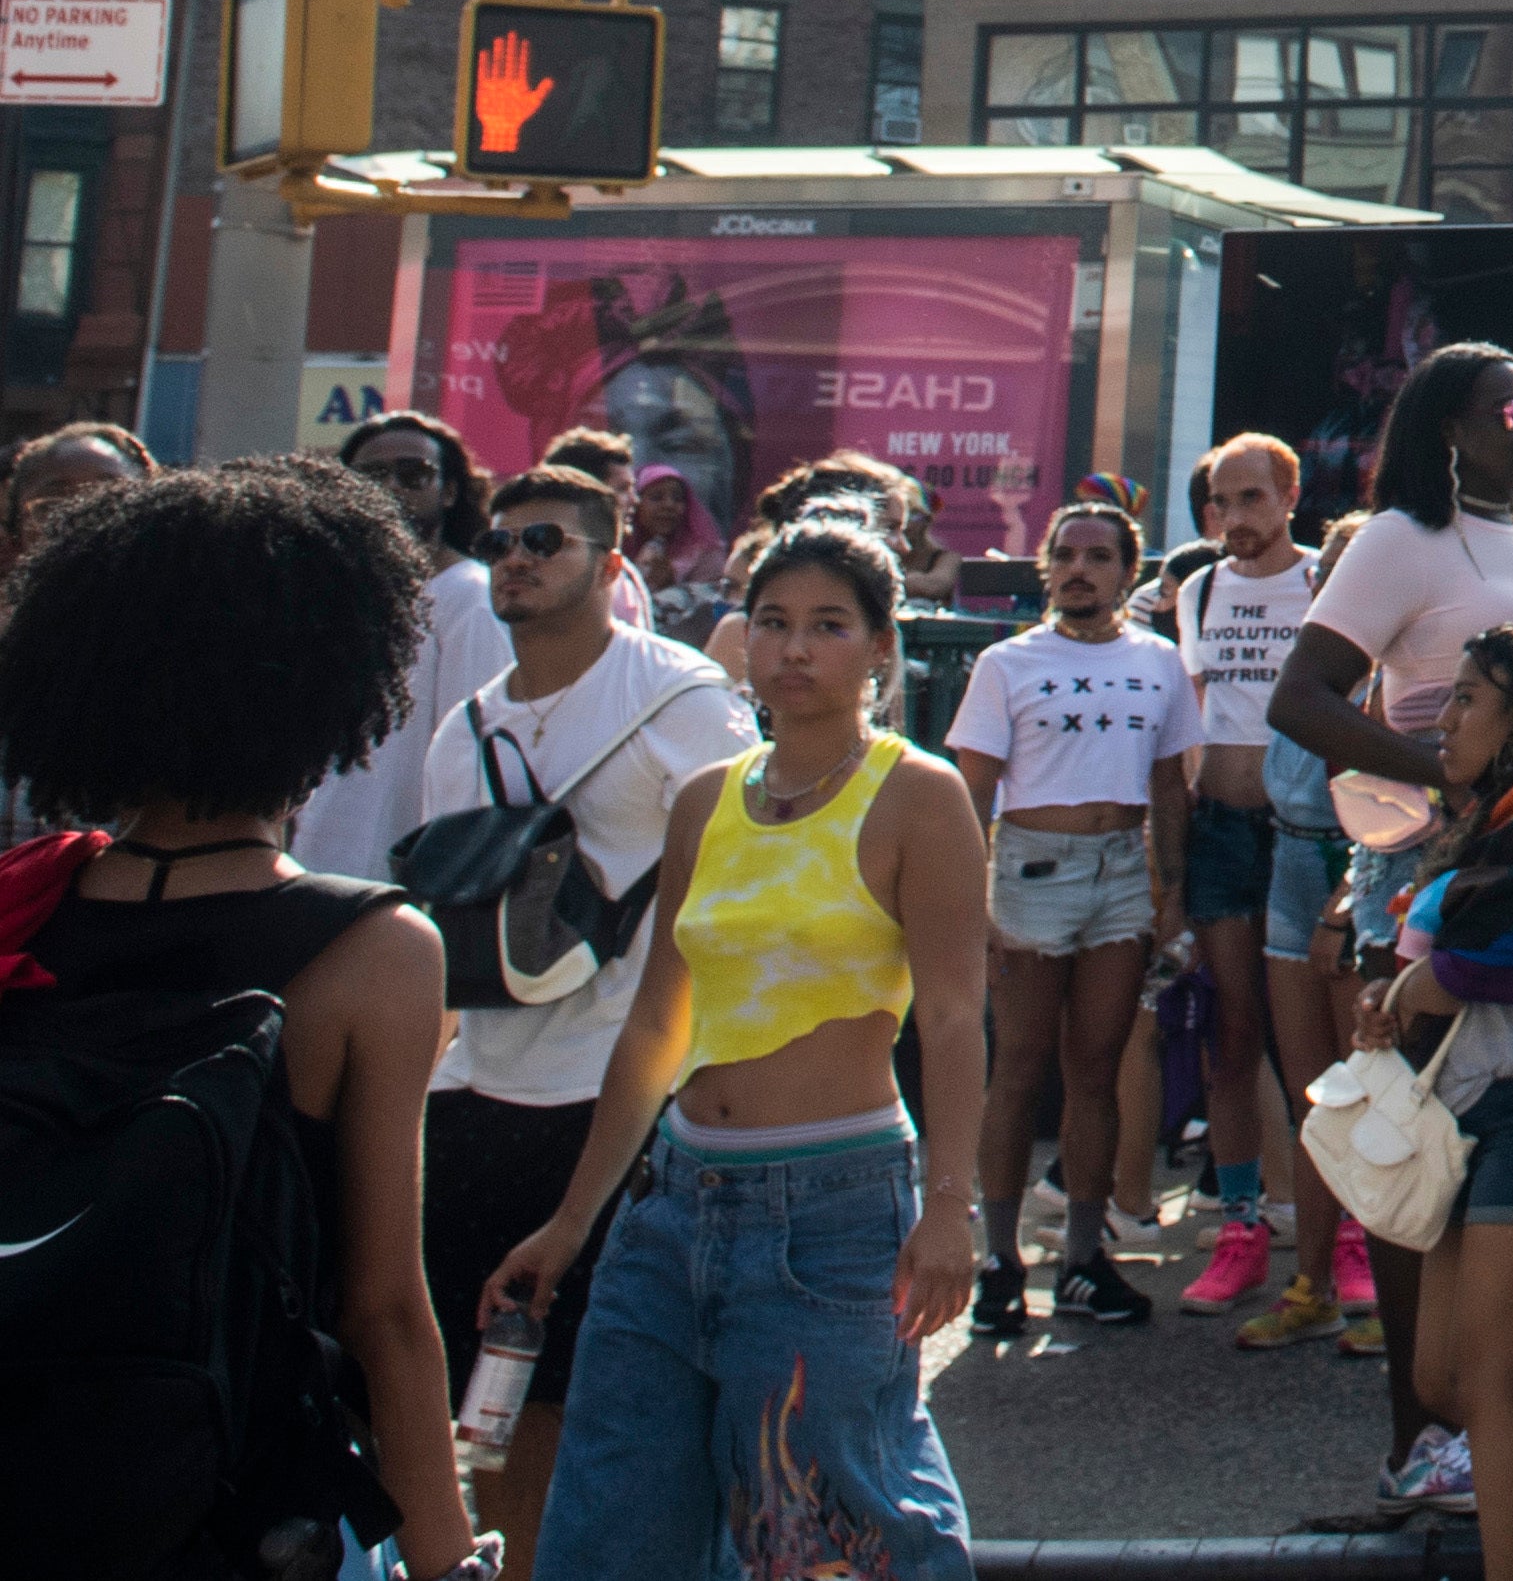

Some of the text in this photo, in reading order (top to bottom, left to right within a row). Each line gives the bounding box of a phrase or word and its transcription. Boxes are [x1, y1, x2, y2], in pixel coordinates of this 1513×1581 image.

[13, 6, 129, 26] NO PARKING
[12, 30, 91, 52] Anytime
[711, 215, 816, 236] JCDecaux
[888, 431, 1019, 458] NEW YORK,
[1231, 604, 1268, 619] THE
[1218, 647, 1268, 661] IS MY
